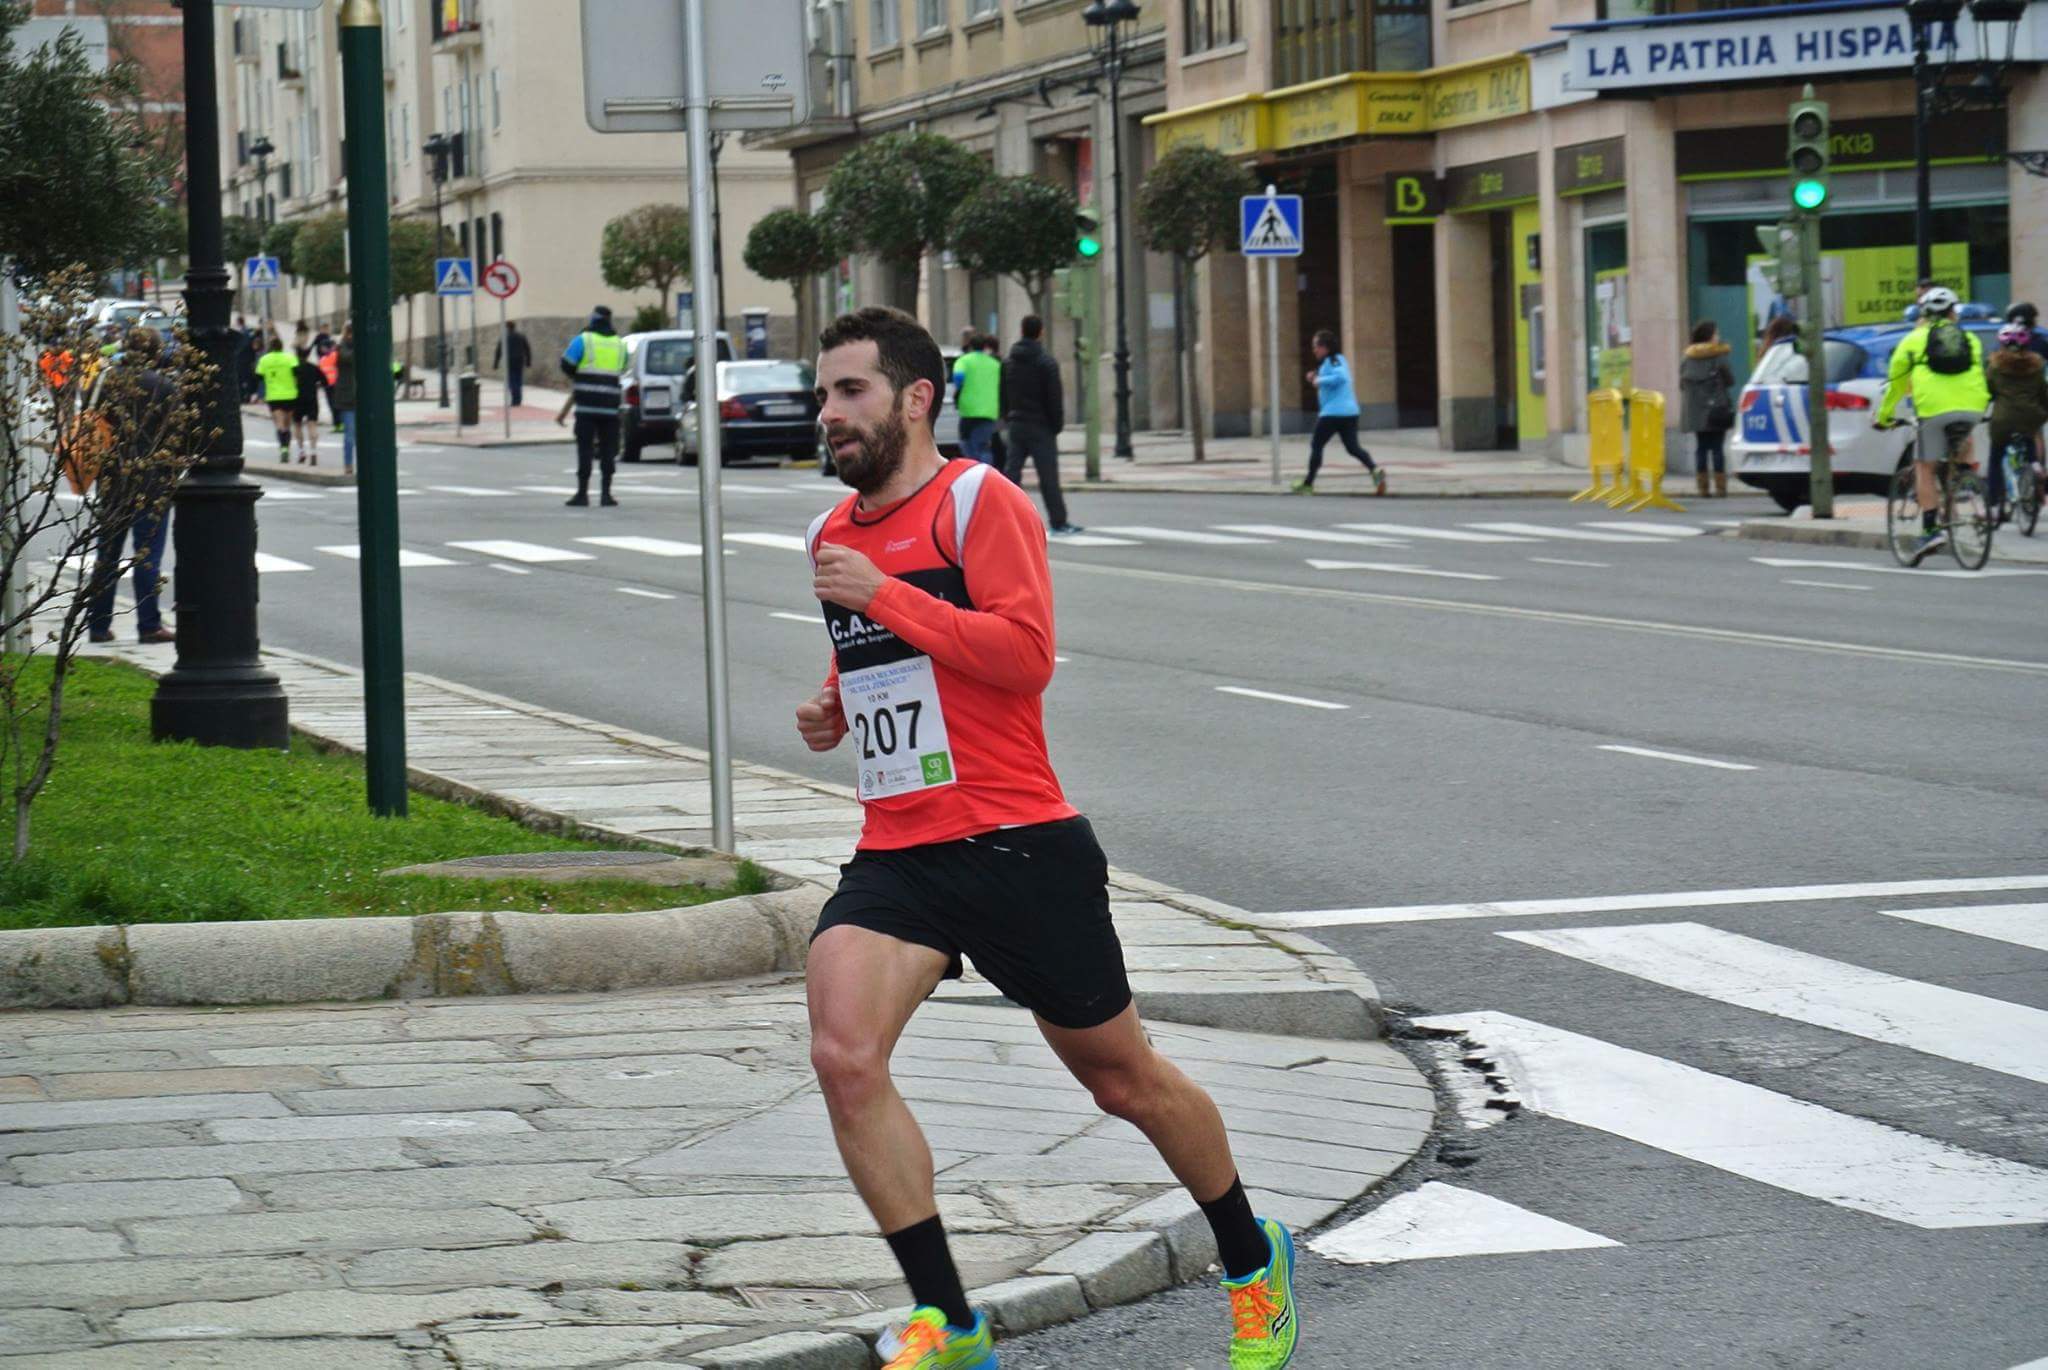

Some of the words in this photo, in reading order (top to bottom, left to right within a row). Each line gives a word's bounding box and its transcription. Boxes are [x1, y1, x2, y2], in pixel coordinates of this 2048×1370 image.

[1588, 46, 1631, 77] LA
[1648, 34, 1776, 73] PATRIA
[1396, 177, 1427, 213] B
[855, 700, 922, 760] 207
